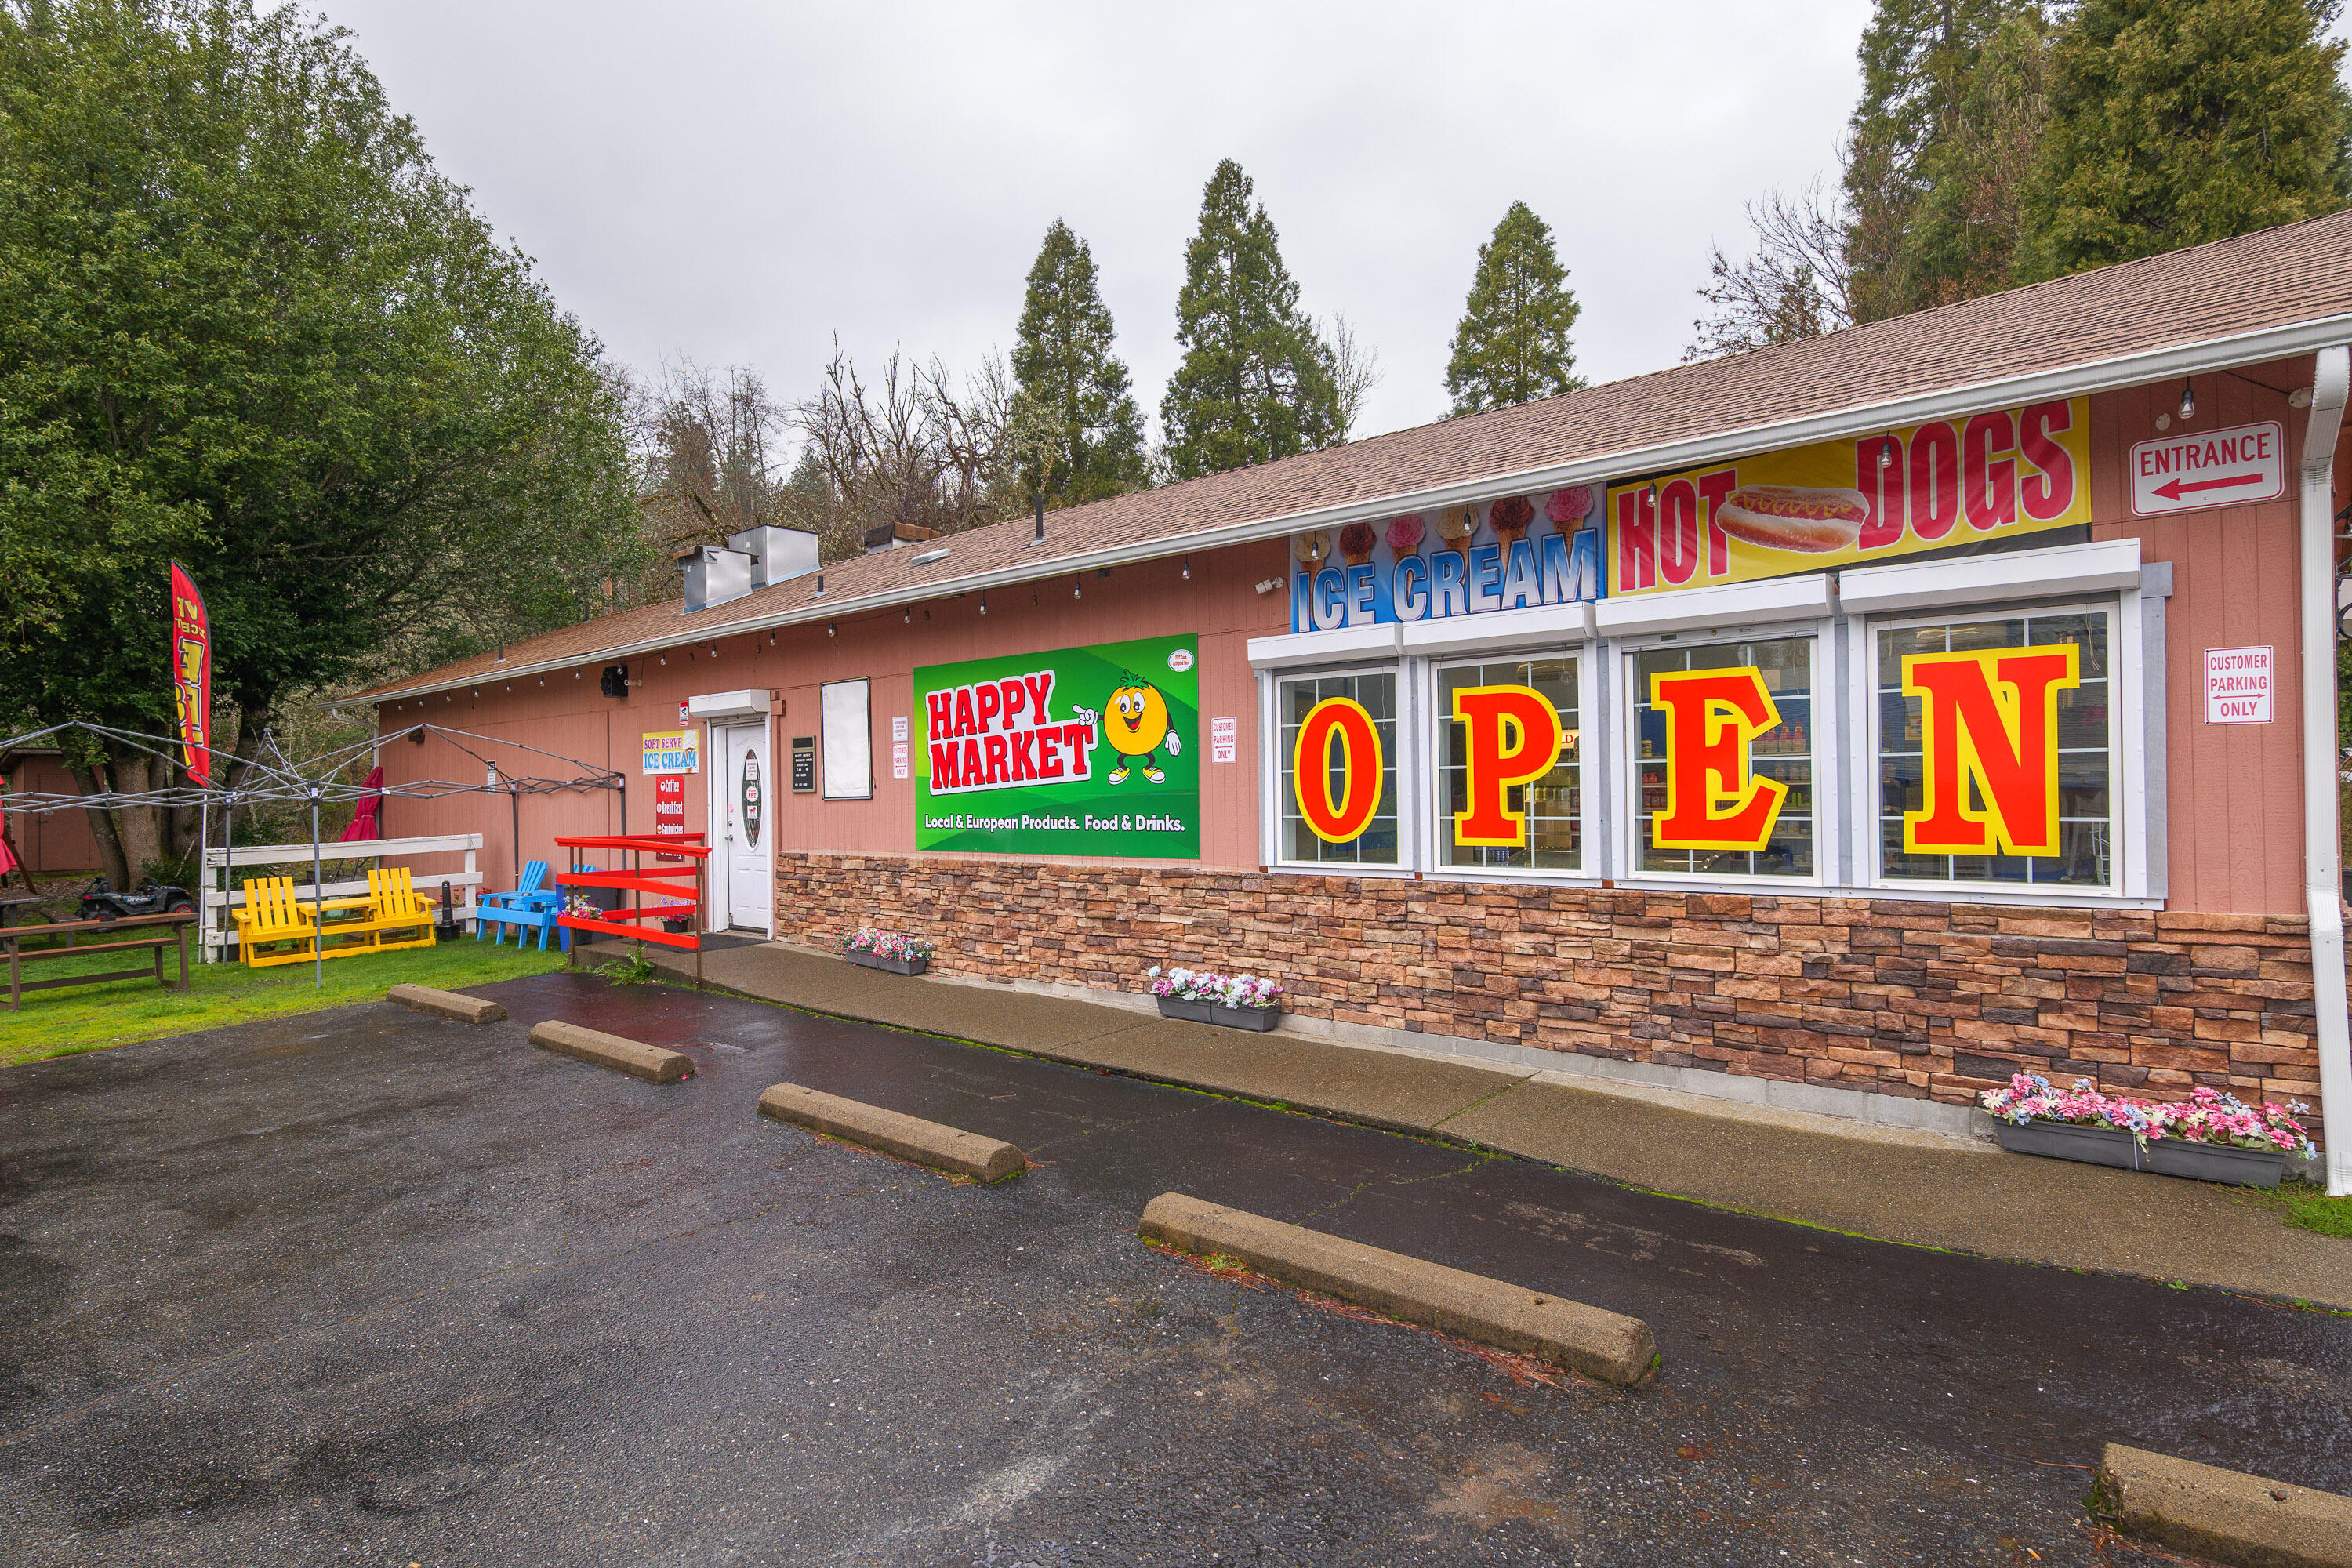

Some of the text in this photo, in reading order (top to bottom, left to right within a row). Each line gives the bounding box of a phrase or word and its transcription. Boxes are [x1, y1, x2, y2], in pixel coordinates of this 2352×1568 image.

[2140, 432, 2271, 477] ENTRANCE
[1617, 400, 2076, 593] HOT DOGS
[1297, 528, 1597, 633] ICE CREAM
[2210, 654, 2267, 670] CUSTOMER
[2210, 676, 2267, 691] PARKING
[927, 673, 1051, 741] HAPPY
[2220, 702, 2258, 717] ONLY
[1214, 722, 1233, 731] CUSTOMER
[644, 737, 682, 750] SOFT SERVE
[1214, 735, 1234, 744] PARKING
[644, 750, 696, 768] ICE CREAM
[931, 724, 1094, 790] MARKET
[1218, 750, 1231, 759] ONLY
[1294, 643, 2080, 859] OPEN
[665, 779, 680, 793] Coffee
[661, 801, 683, 815] Breakfast
[924, 814, 1185, 833] Local & European Products. Food & Drinks.
